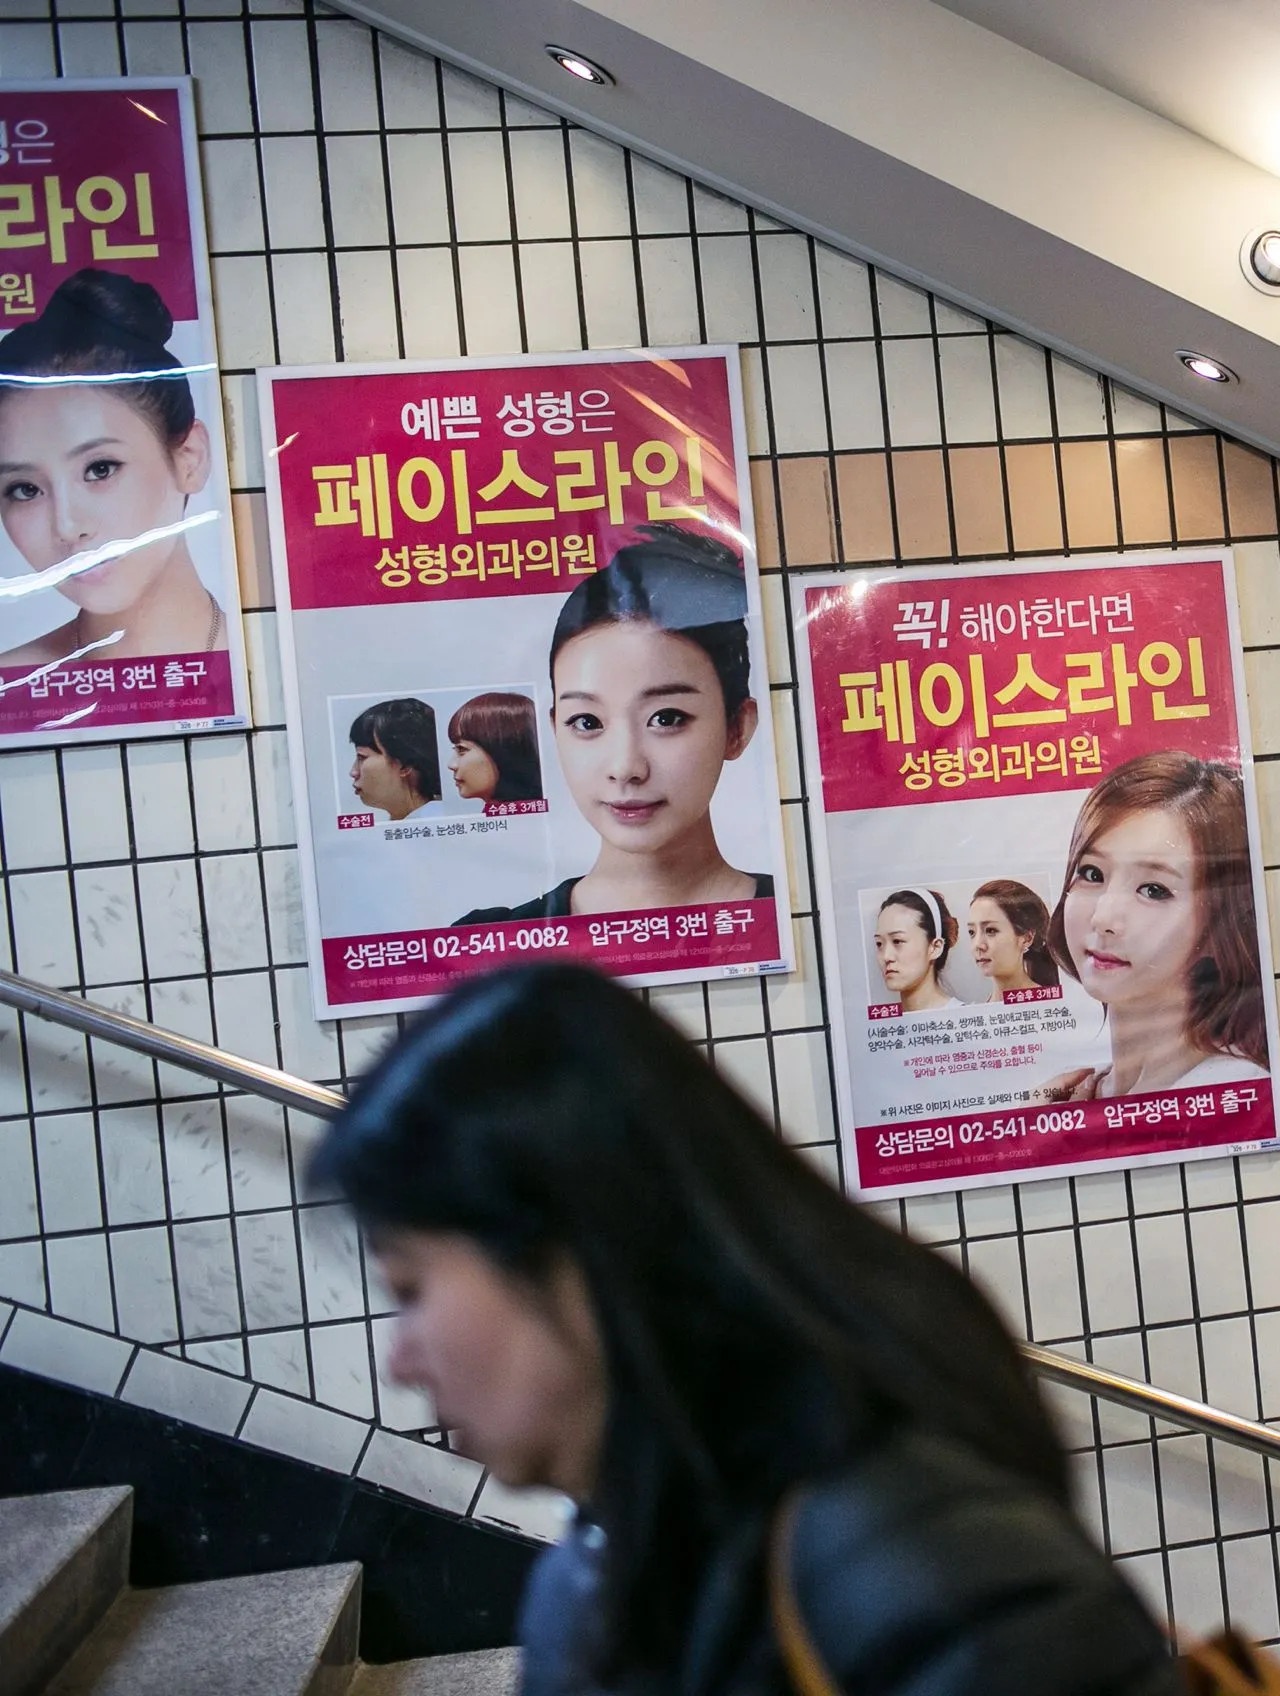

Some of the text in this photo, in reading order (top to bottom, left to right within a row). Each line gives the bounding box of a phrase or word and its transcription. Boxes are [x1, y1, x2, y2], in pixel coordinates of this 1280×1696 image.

[0, 120, 54, 164] 은
[401, 389, 616, 441] 예쁜 성형은
[312, 436, 708, 539] 페이스라인
[375, 535, 598, 587] 성형외과의원
[893, 593, 1134, 649] 꼭! 해야한다면
[28, 667, 116, 698] 압구정역
[122, 664, 157, 690] 3번
[163, 661, 207, 687] 출구
[839, 637, 1210, 744] 페이스라인
[899, 736, 1102, 790] 성형외과의원
[340, 815, 371, 828] 수술전
[489, 800, 546, 816] 수술후 3개월
[343, 909, 754, 970] 상담문의 02-541-0082 압구정역 3번 출구
[871, 1005, 899, 1017] 수술전
[1007, 987, 1060, 1002] 수술후 3개월
[875, 1125, 954, 1157] 상담문의
[959, 1109, 1086, 1144] 02-541-0082
[1104, 1096, 1180, 1129] 압구정역
[1185, 1093, 1215, 1117] 3번
[1220, 1088, 1258, 1113] 출구
